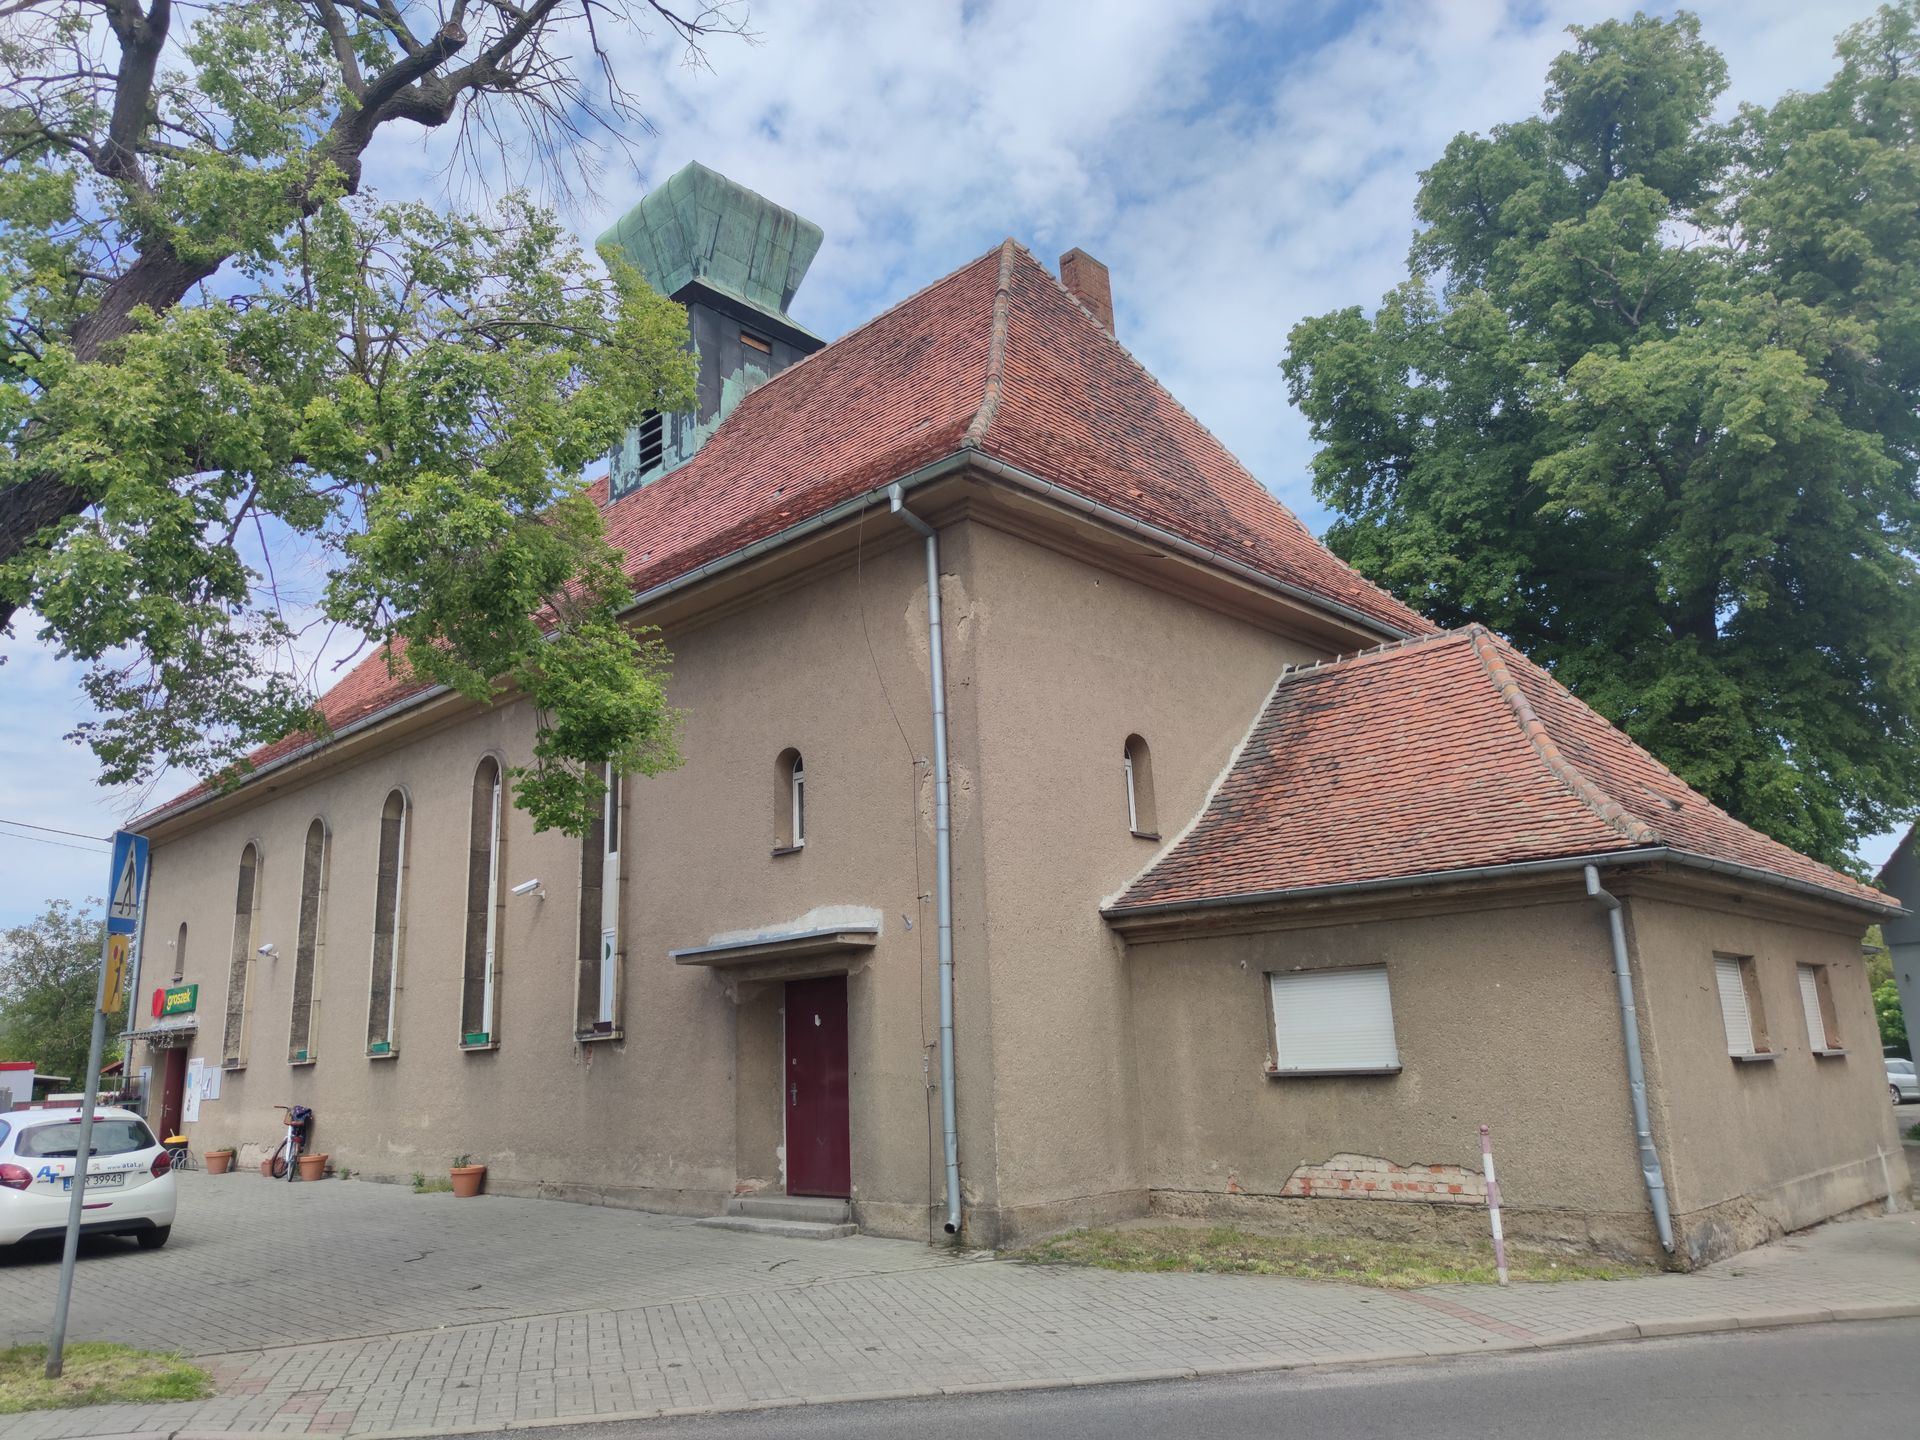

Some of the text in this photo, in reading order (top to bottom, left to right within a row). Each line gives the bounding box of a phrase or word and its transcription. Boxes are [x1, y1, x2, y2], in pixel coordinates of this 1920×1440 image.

[167, 988, 191, 1010] groszek
[37, 1166, 59, 1184] AT
[94, 1174, 122, 1185] 39943
